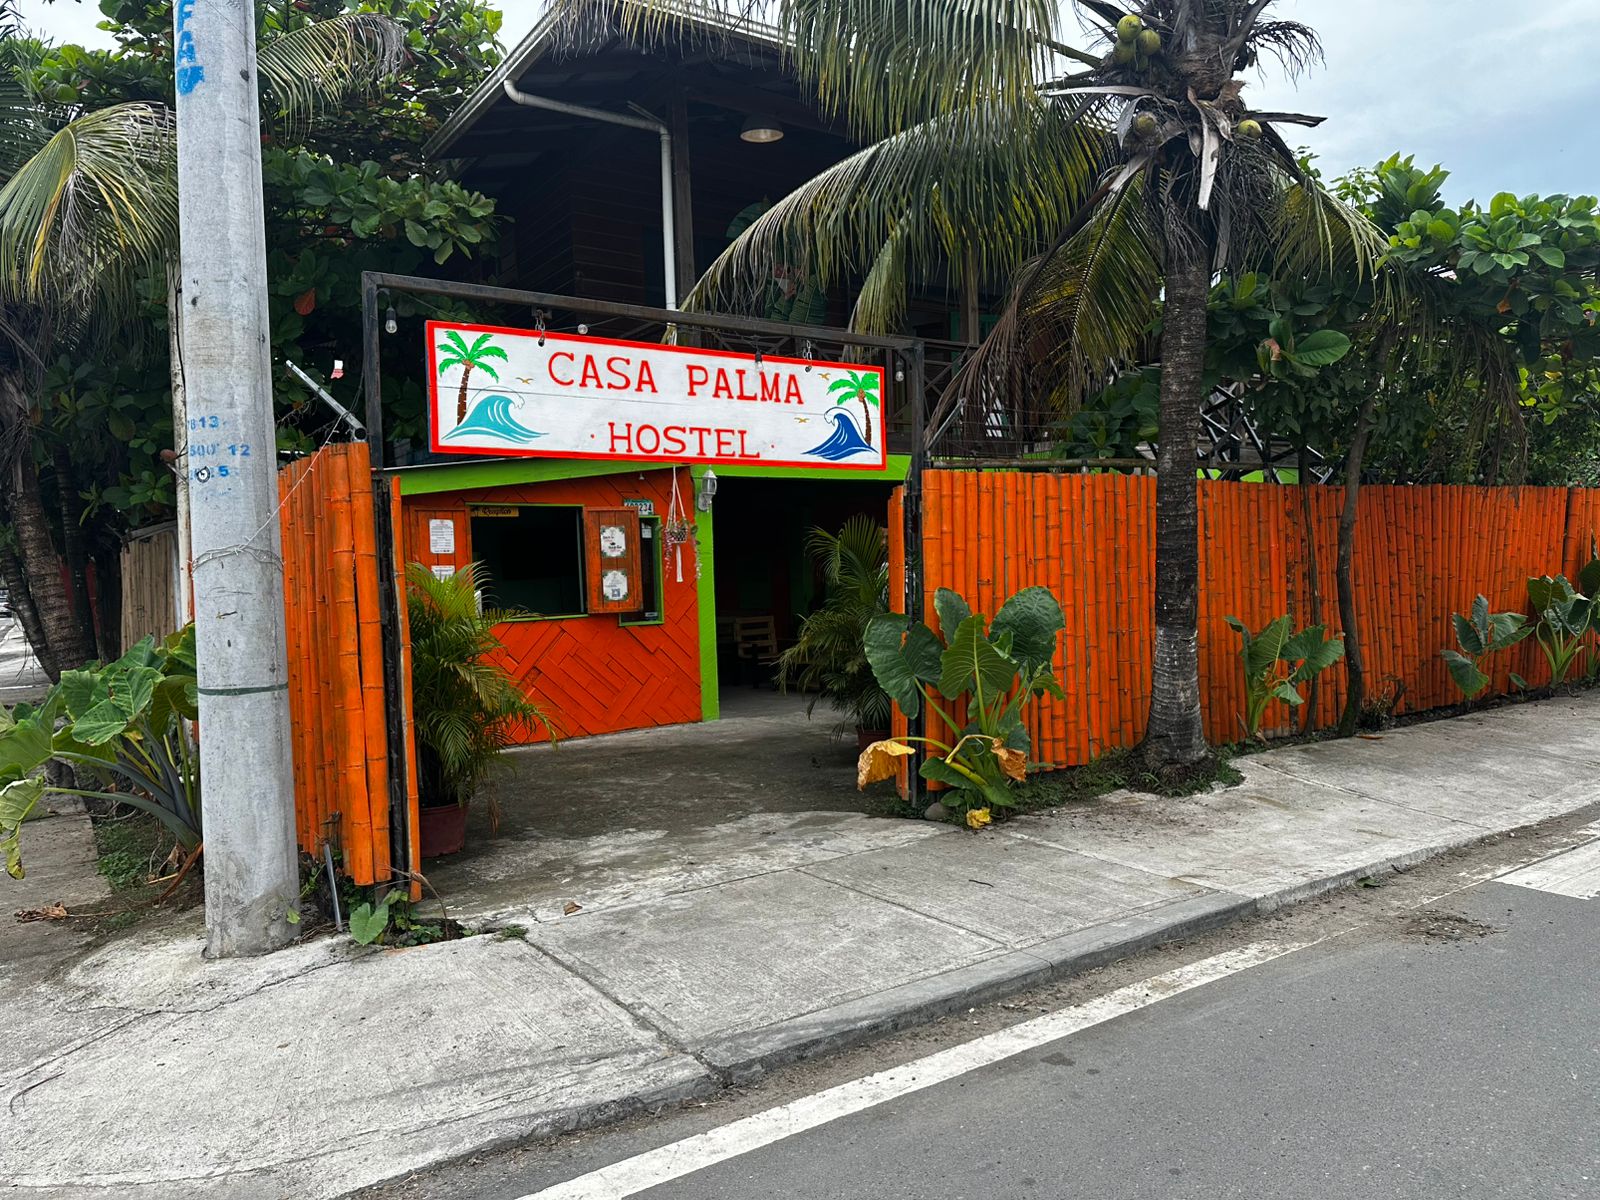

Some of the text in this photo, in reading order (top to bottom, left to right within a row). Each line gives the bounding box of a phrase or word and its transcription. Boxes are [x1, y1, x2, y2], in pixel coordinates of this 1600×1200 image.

[548, 351, 804, 405] CASA PALMA
[227, 444, 251, 456] 12
[608, 422, 760, 458] HOSTEL
